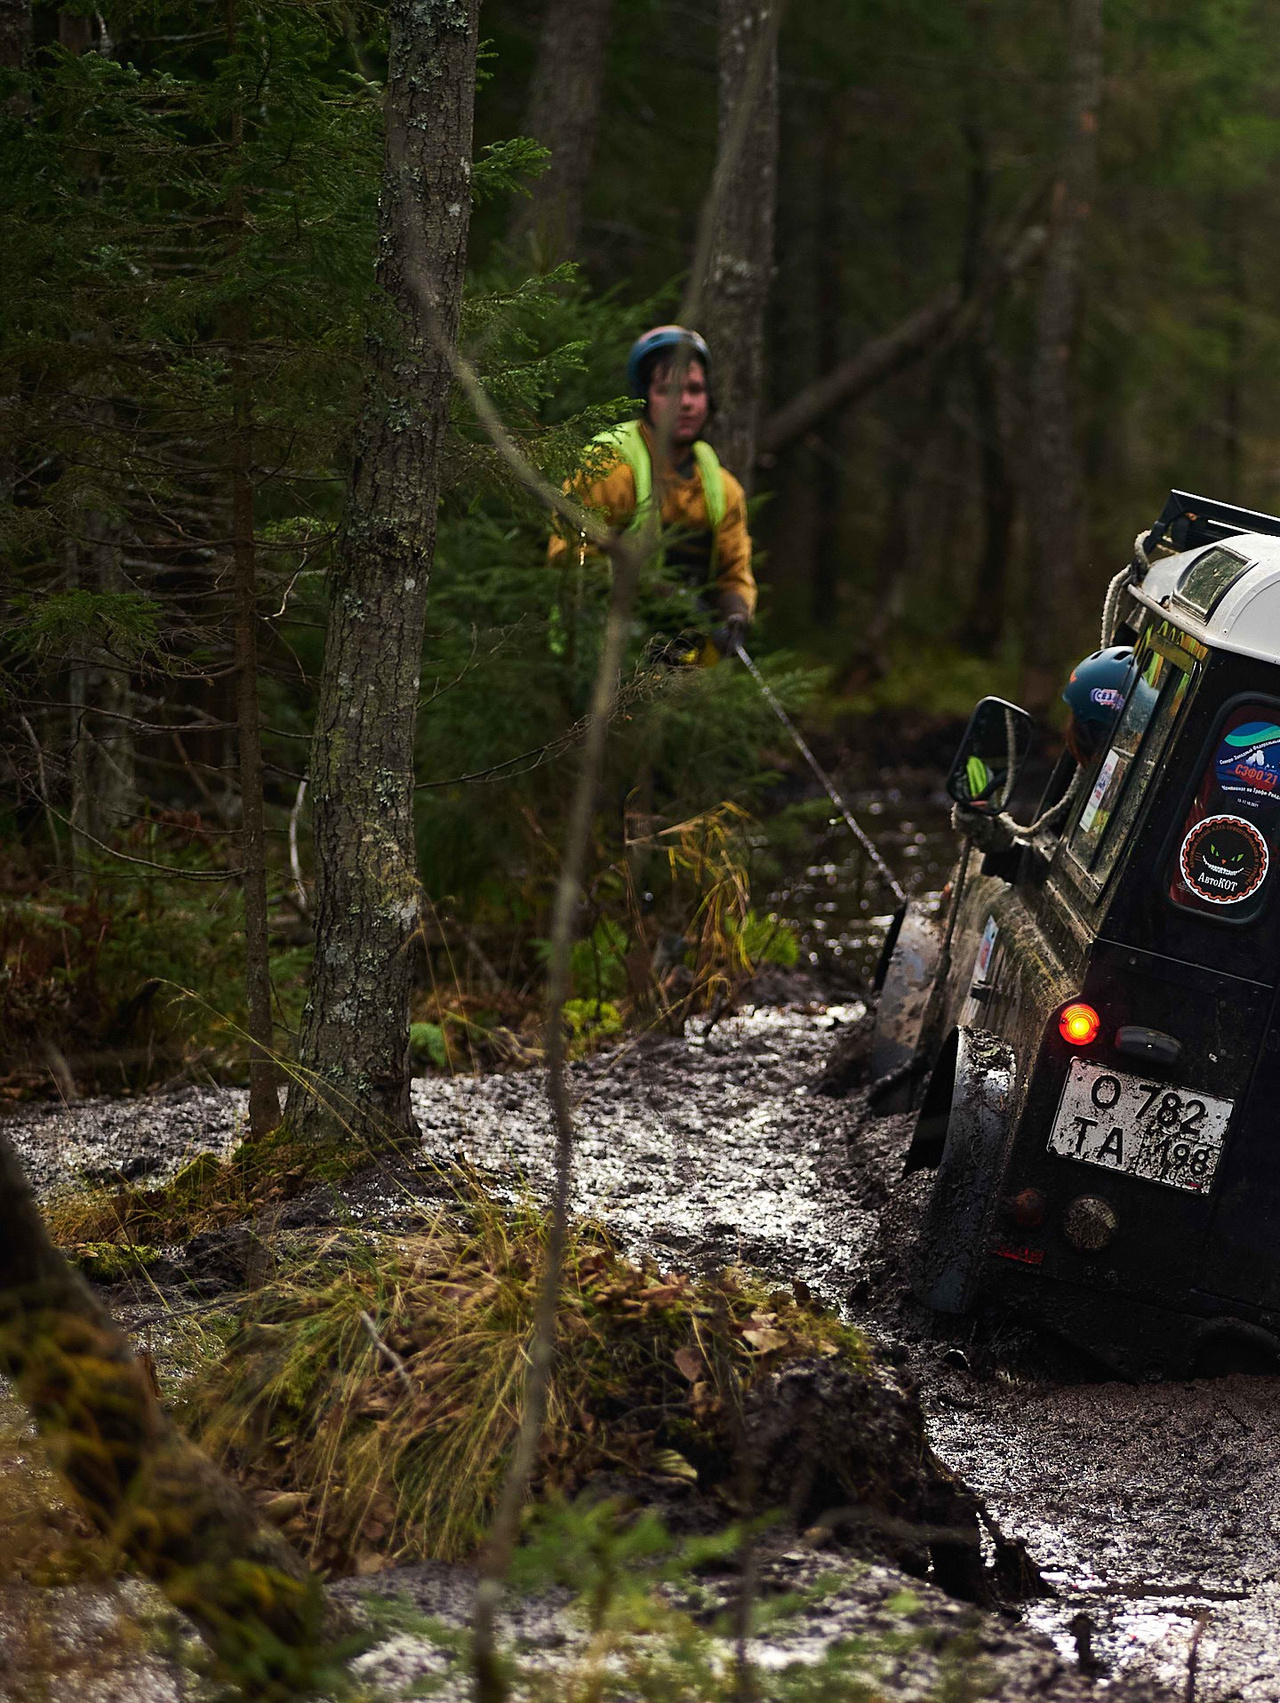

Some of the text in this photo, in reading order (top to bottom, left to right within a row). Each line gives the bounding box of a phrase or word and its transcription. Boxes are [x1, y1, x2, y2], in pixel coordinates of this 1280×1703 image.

[1197, 871, 1239, 892] АвтоКОТ
[1134, 1084, 1208, 1136] 782
[1154, 1136, 1210, 1176] 198
